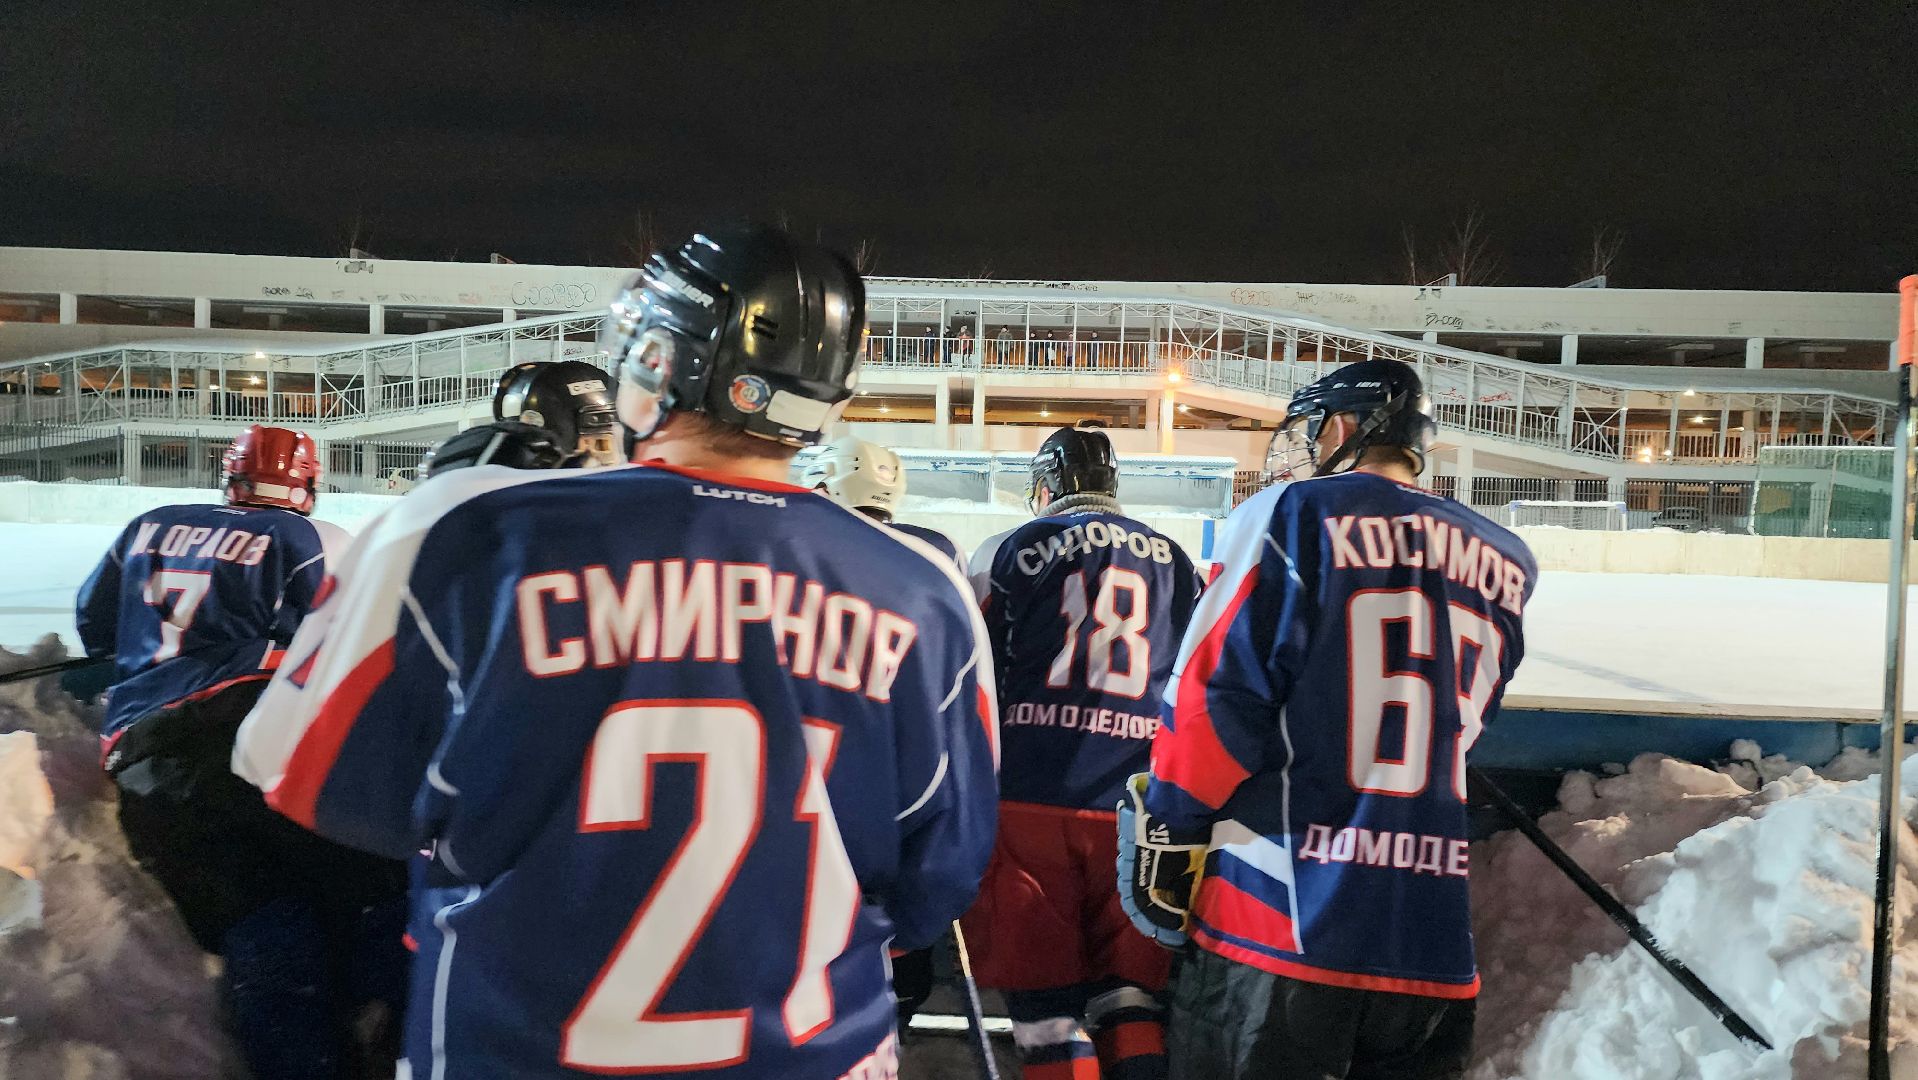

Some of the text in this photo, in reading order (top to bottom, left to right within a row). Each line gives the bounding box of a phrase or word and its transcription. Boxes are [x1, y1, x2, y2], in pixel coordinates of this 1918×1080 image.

[1016, 520, 1173, 577] СИДОРОВ
[1325, 513, 1526, 616] КОСИМОВ
[142, 567, 213, 665] 7
[517, 557, 918, 704] СМИРНОВ
[1046, 563, 1151, 701] 18
[560, 698, 863, 1074] 21
